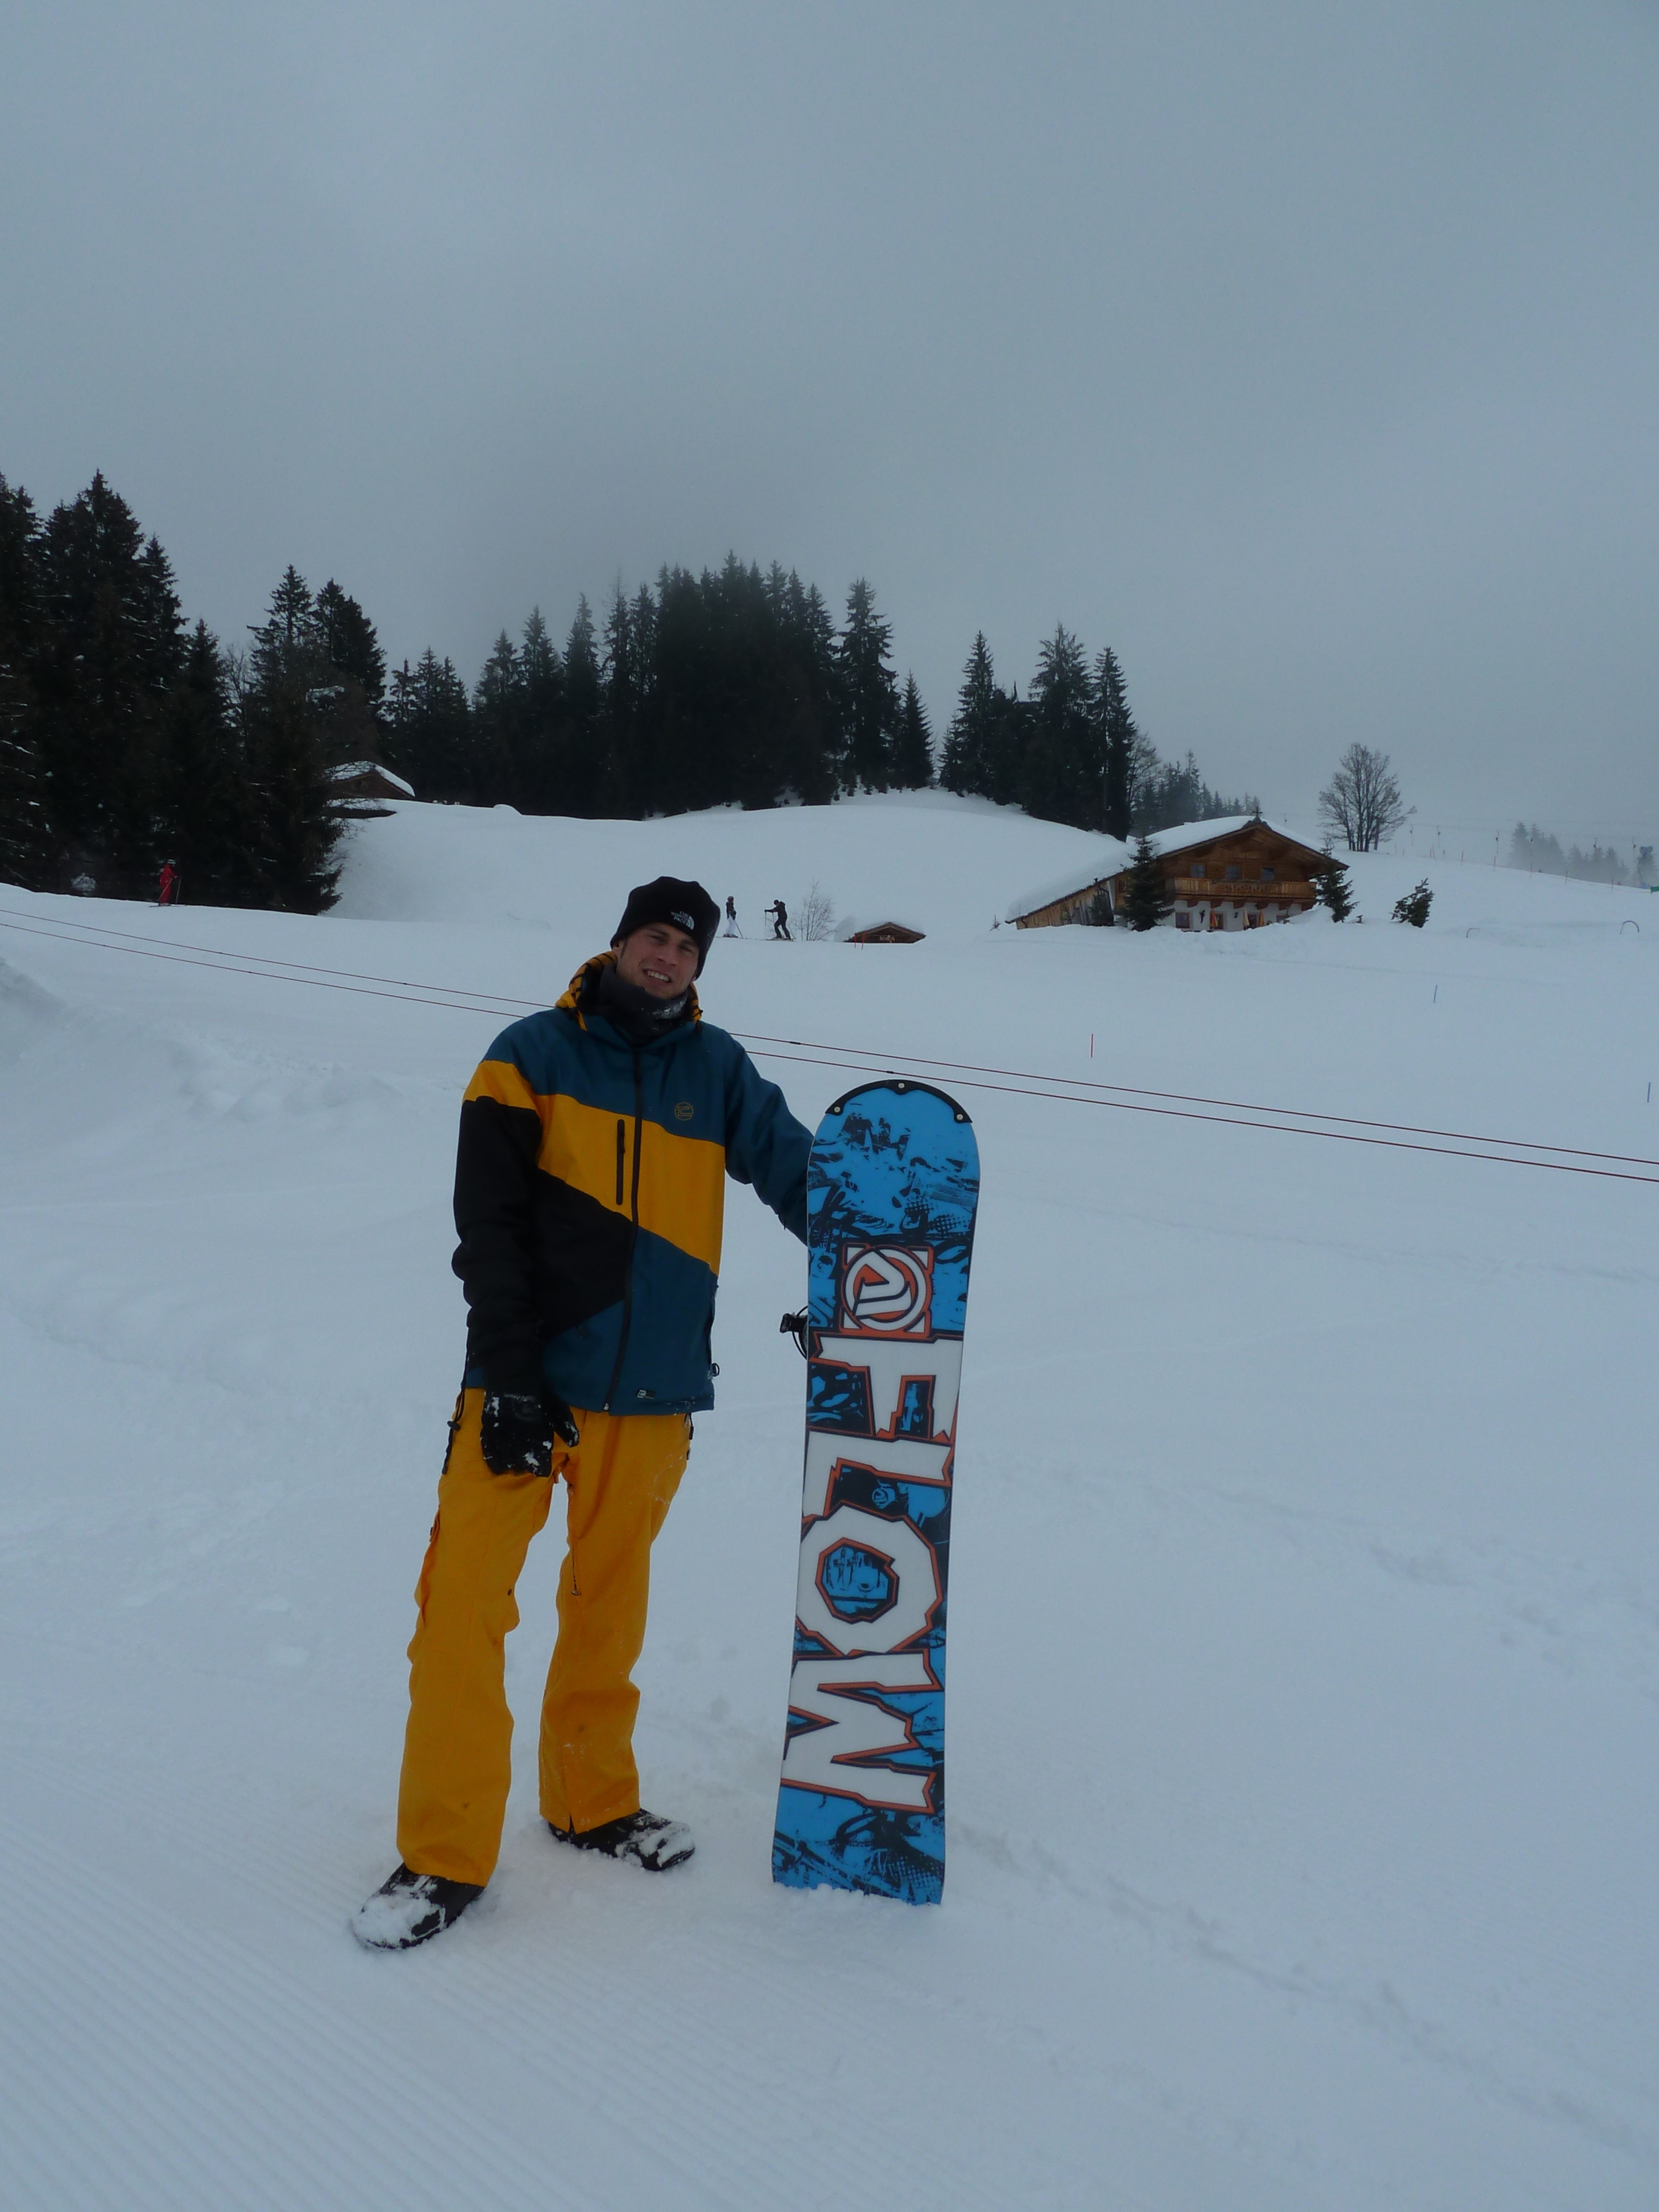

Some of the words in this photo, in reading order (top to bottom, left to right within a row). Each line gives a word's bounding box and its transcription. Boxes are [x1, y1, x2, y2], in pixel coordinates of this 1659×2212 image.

[670, 911, 688, 920] NORTH
[674, 916, 686, 924] FACE
[780, 1330, 966, 1815] FLOW
